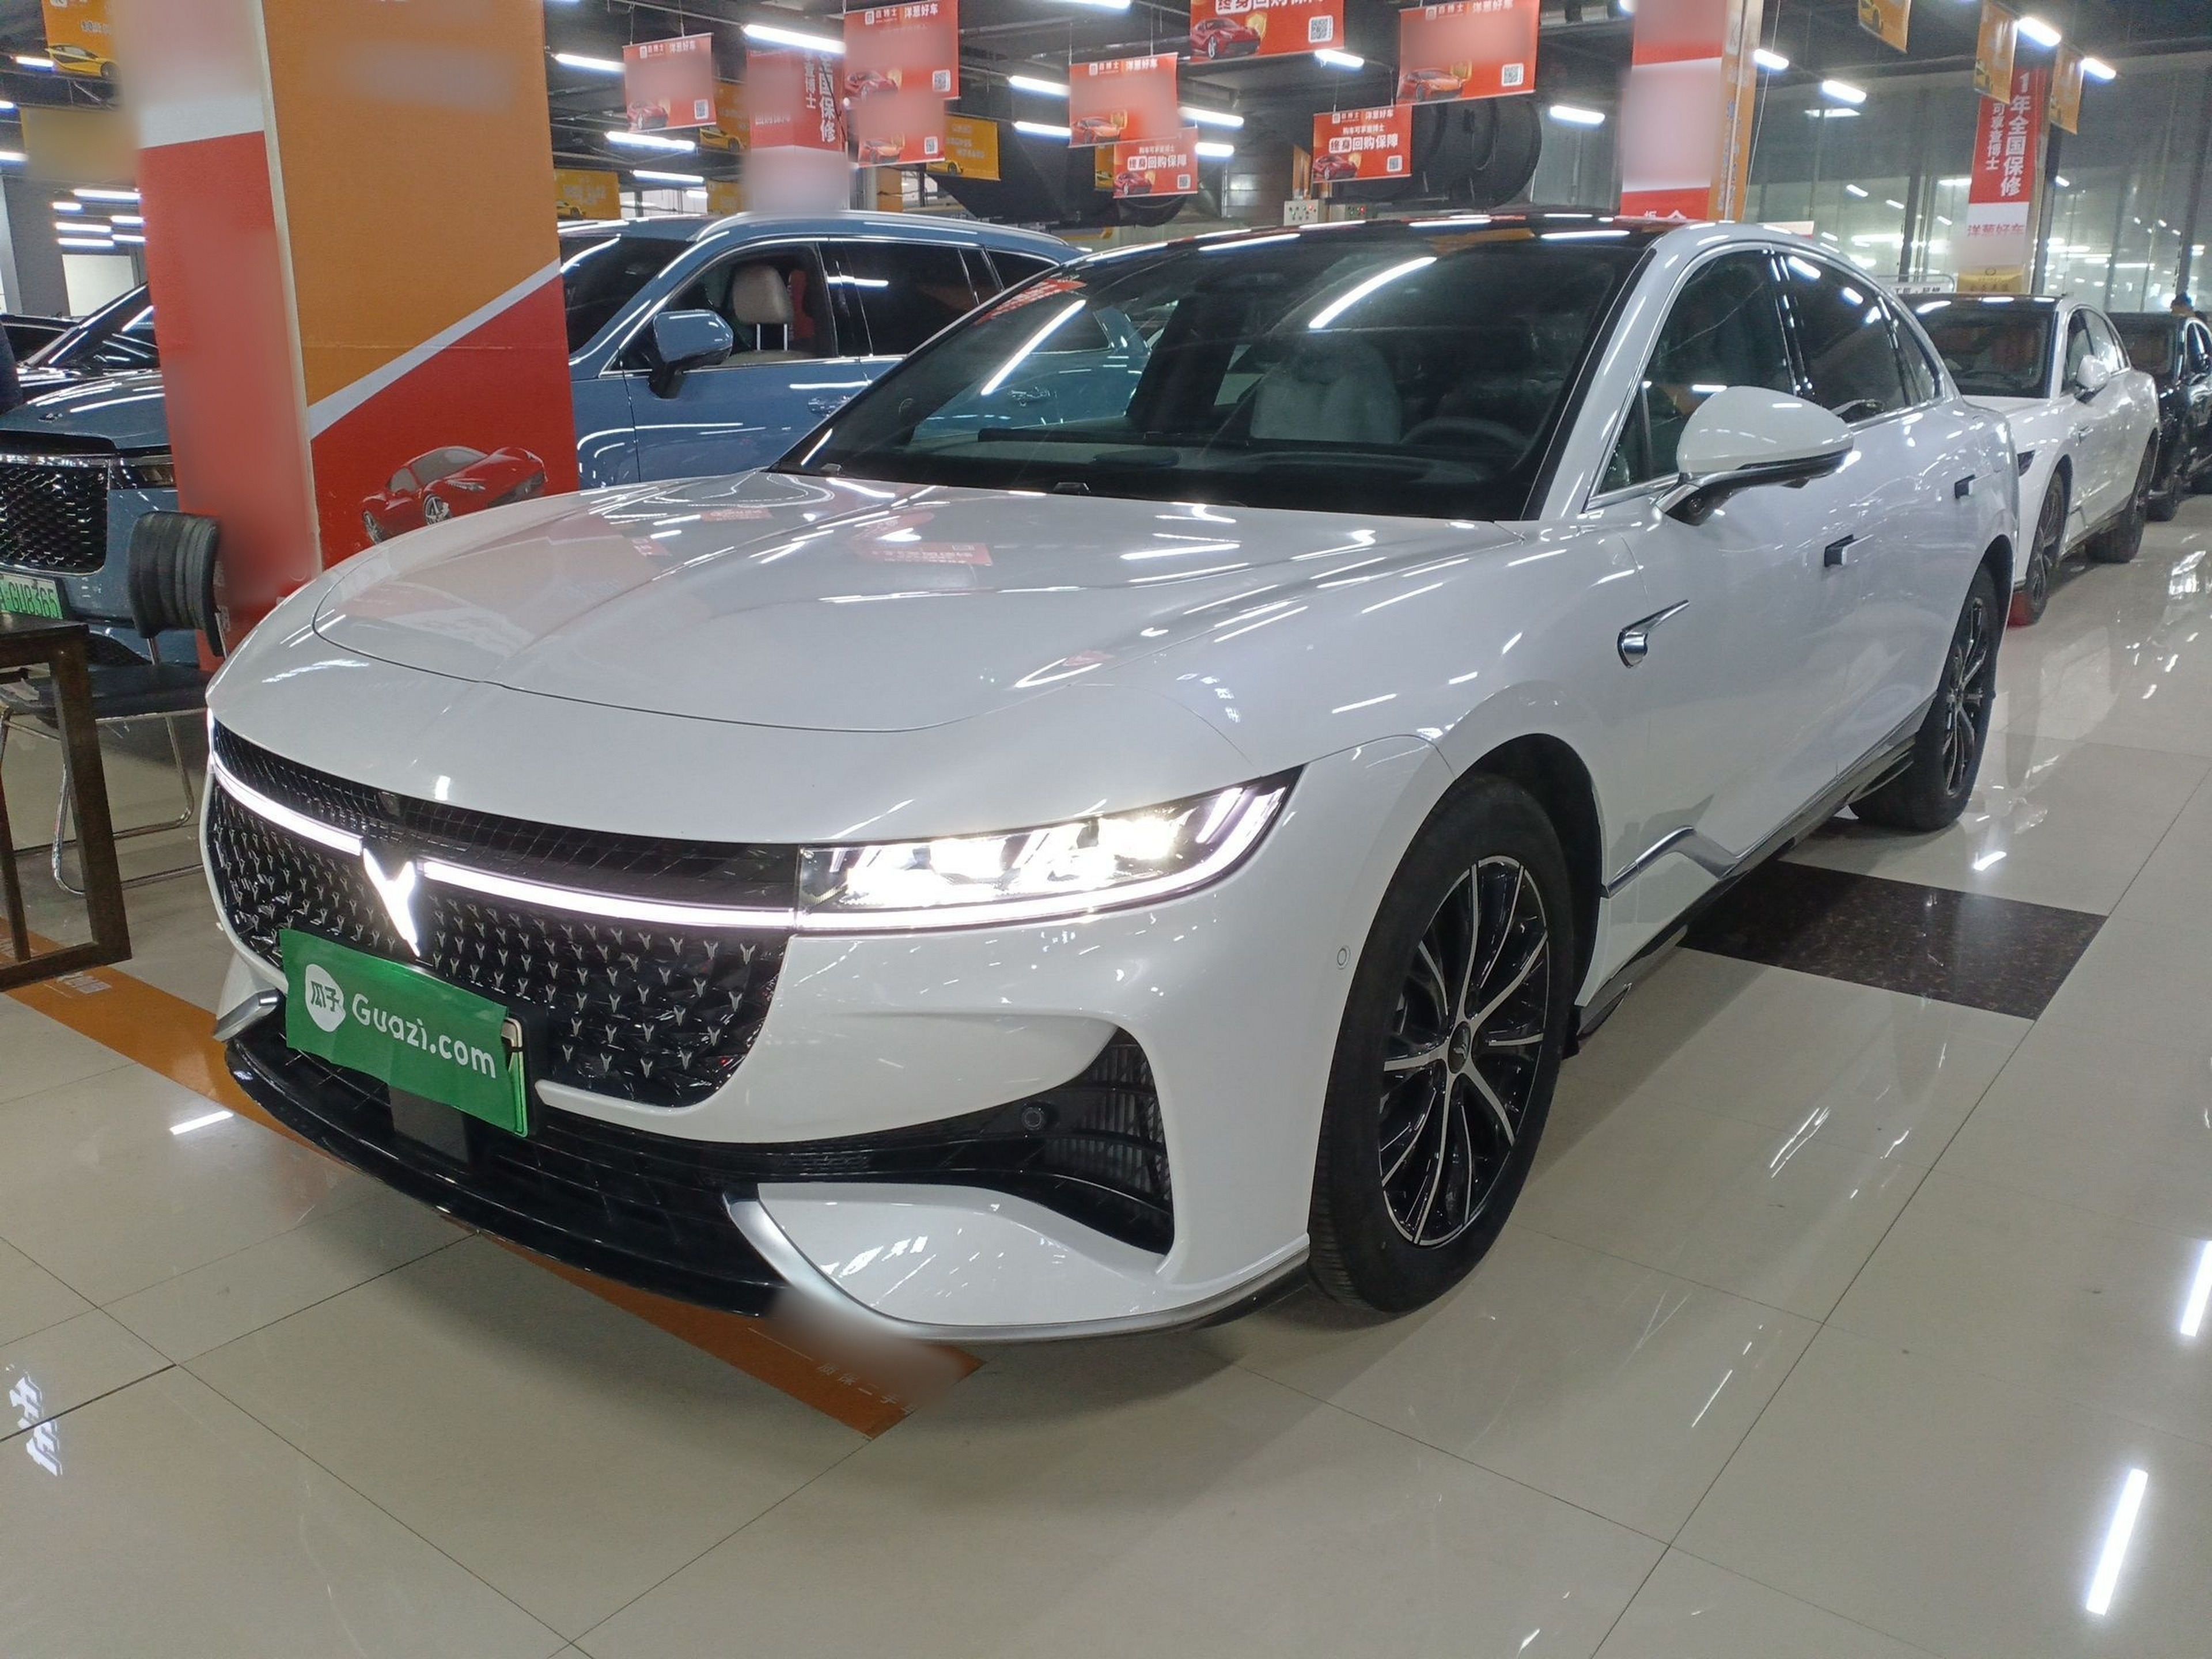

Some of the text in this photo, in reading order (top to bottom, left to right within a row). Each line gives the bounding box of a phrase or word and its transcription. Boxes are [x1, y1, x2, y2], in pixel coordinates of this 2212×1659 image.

[1330, 134, 1398, 154] 终身回购保障
[2001, 72, 2031, 197] 1年全国保修
[1128, 154, 1187, 171] 终身回购保障
[310, 981, 340, 1012] 瓜子
[353, 993, 497, 1079] Guazi.com
